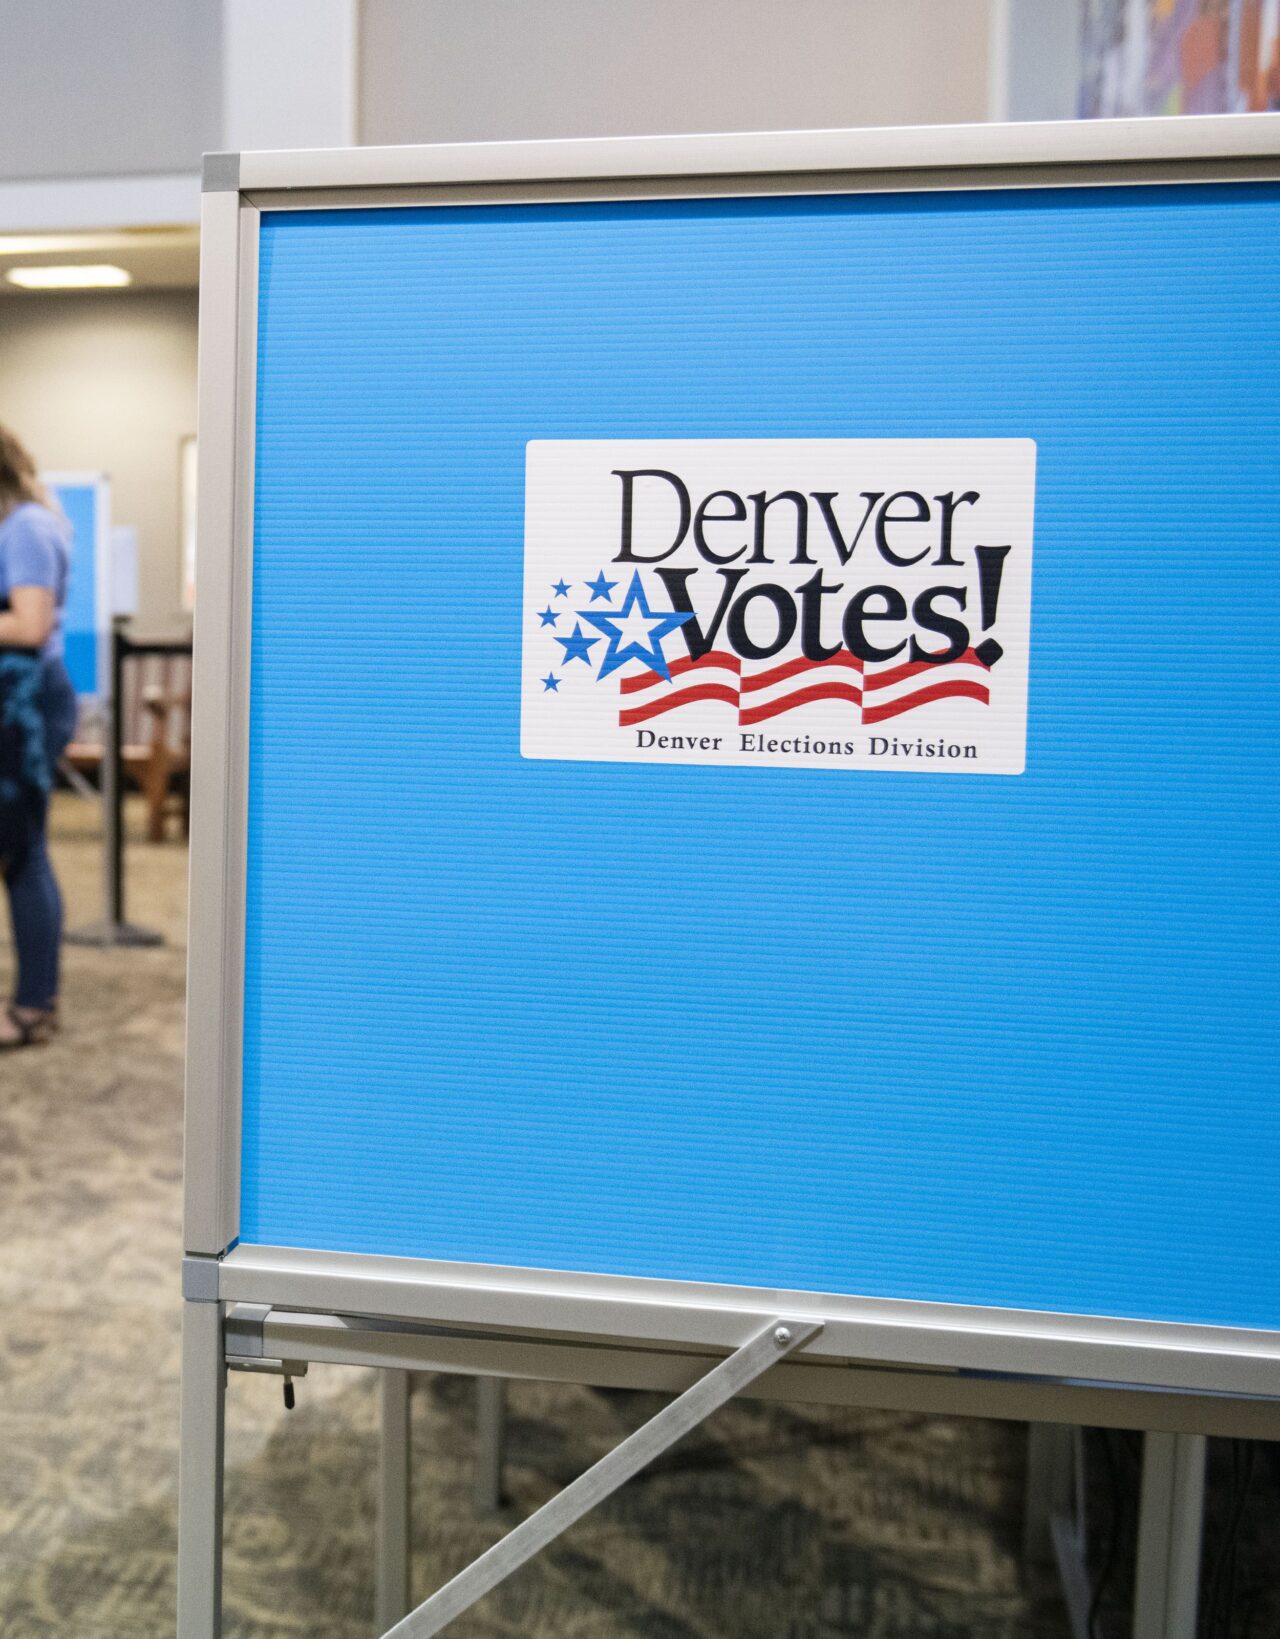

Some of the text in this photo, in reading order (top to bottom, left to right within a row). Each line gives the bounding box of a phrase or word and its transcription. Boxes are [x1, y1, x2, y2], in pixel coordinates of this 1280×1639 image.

[610, 469, 981, 566] Denver
[654, 545, 1012, 667] Votes!
[635, 729, 978, 759] Denver Elections Division
